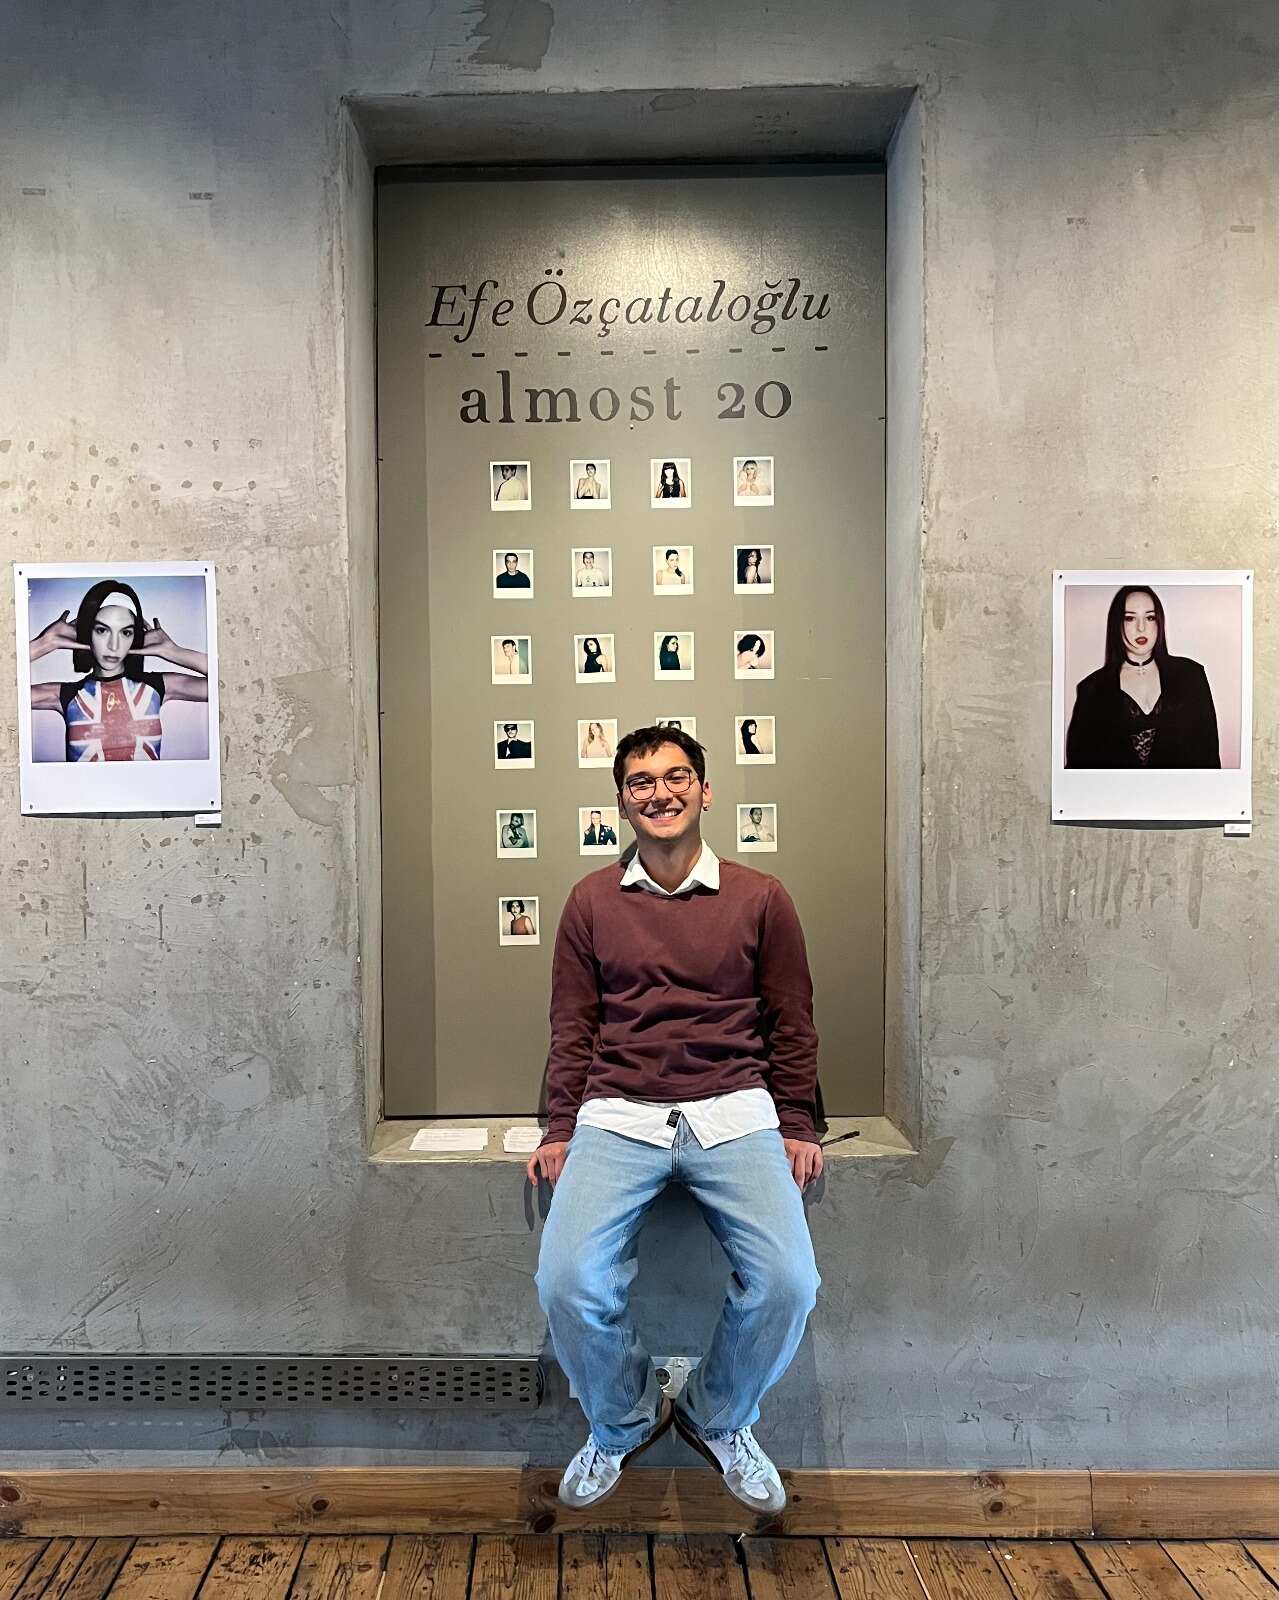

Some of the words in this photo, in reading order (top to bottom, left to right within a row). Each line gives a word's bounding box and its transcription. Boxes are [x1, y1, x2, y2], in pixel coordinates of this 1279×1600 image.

[424, 279, 515, 344] Efe
[526, 268, 831, 338] Özçataloğlu
[459, 370, 683, 424] almost
[717, 380, 792, 420] 20
